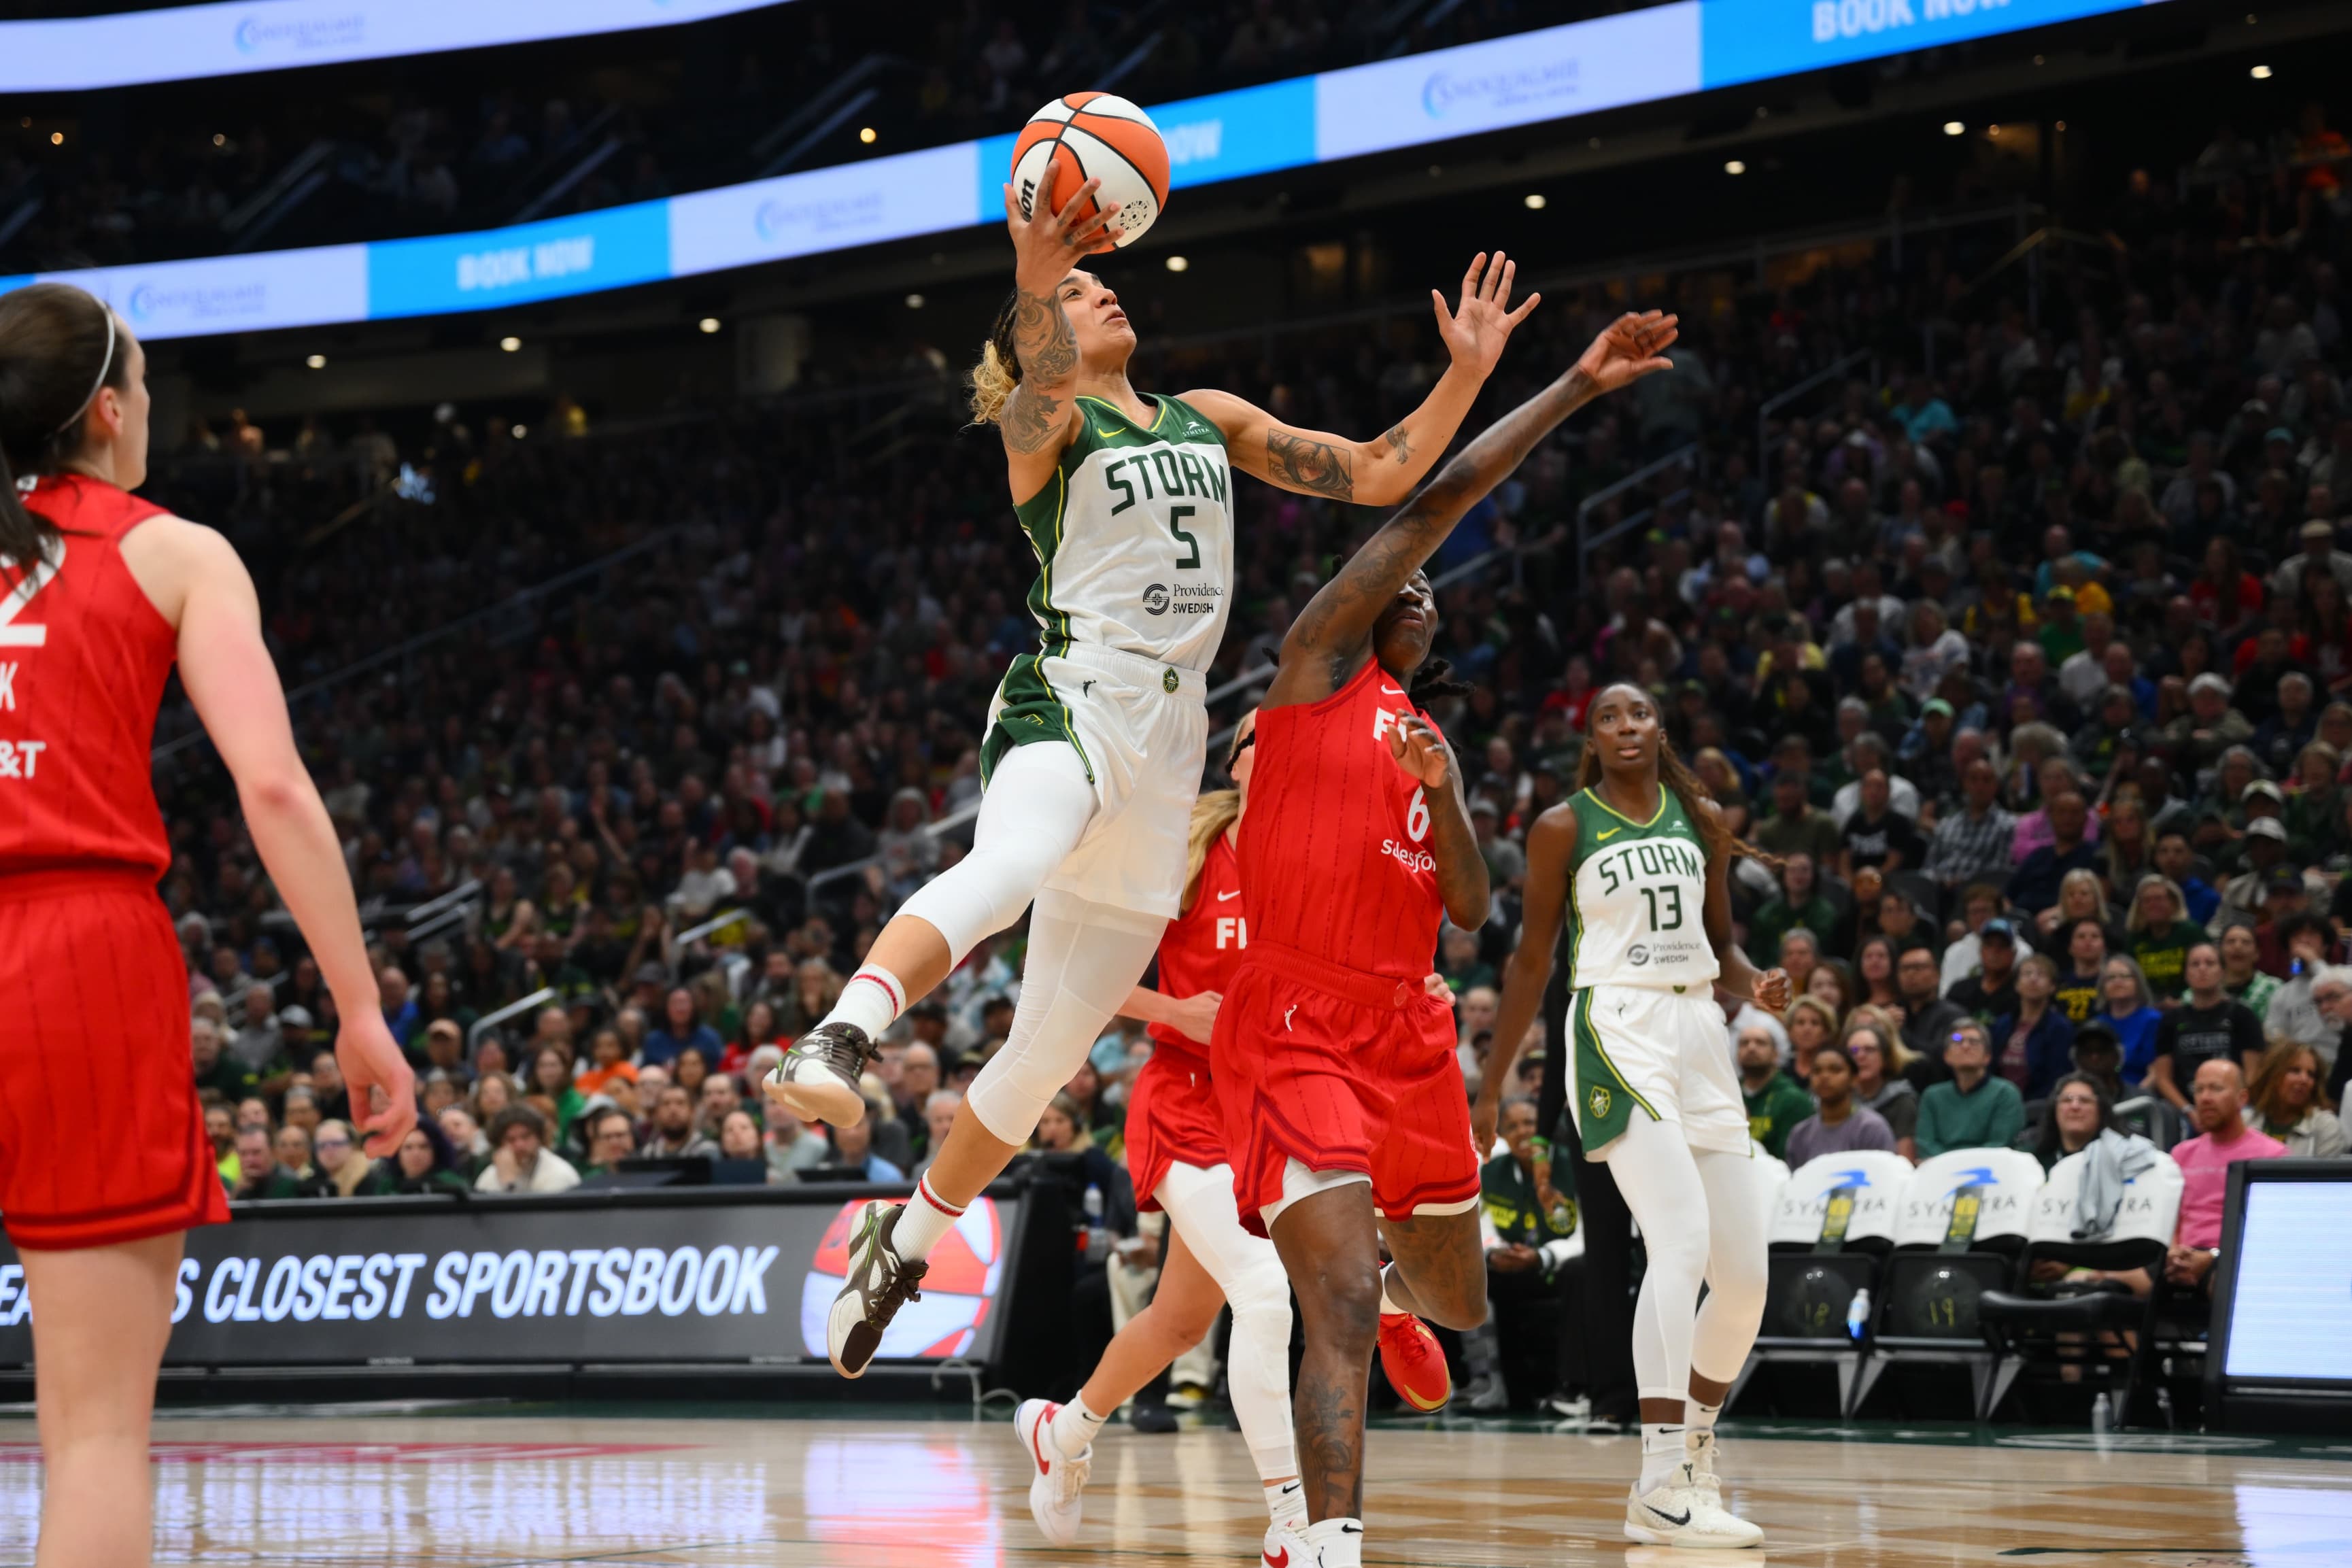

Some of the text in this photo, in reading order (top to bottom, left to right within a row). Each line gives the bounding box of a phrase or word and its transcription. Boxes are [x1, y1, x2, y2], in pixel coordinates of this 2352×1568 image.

[1182, 428, 1210, 437] SYMETRA
[1105, 449, 1227, 517] STORM
[1170, 505, 1201, 570] 5
[1172, 602, 1214, 614] SWEDISH
[1173, 582, 1225, 597] Providence
[1598, 843, 1701, 898] STORM
[1640, 885, 1683, 932] 13
[1653, 954, 1689, 964] SWEDISH
[205, 1252, 427, 1324] CLOSEST
[426, 1245, 780, 1319] SPORTSBOOK
